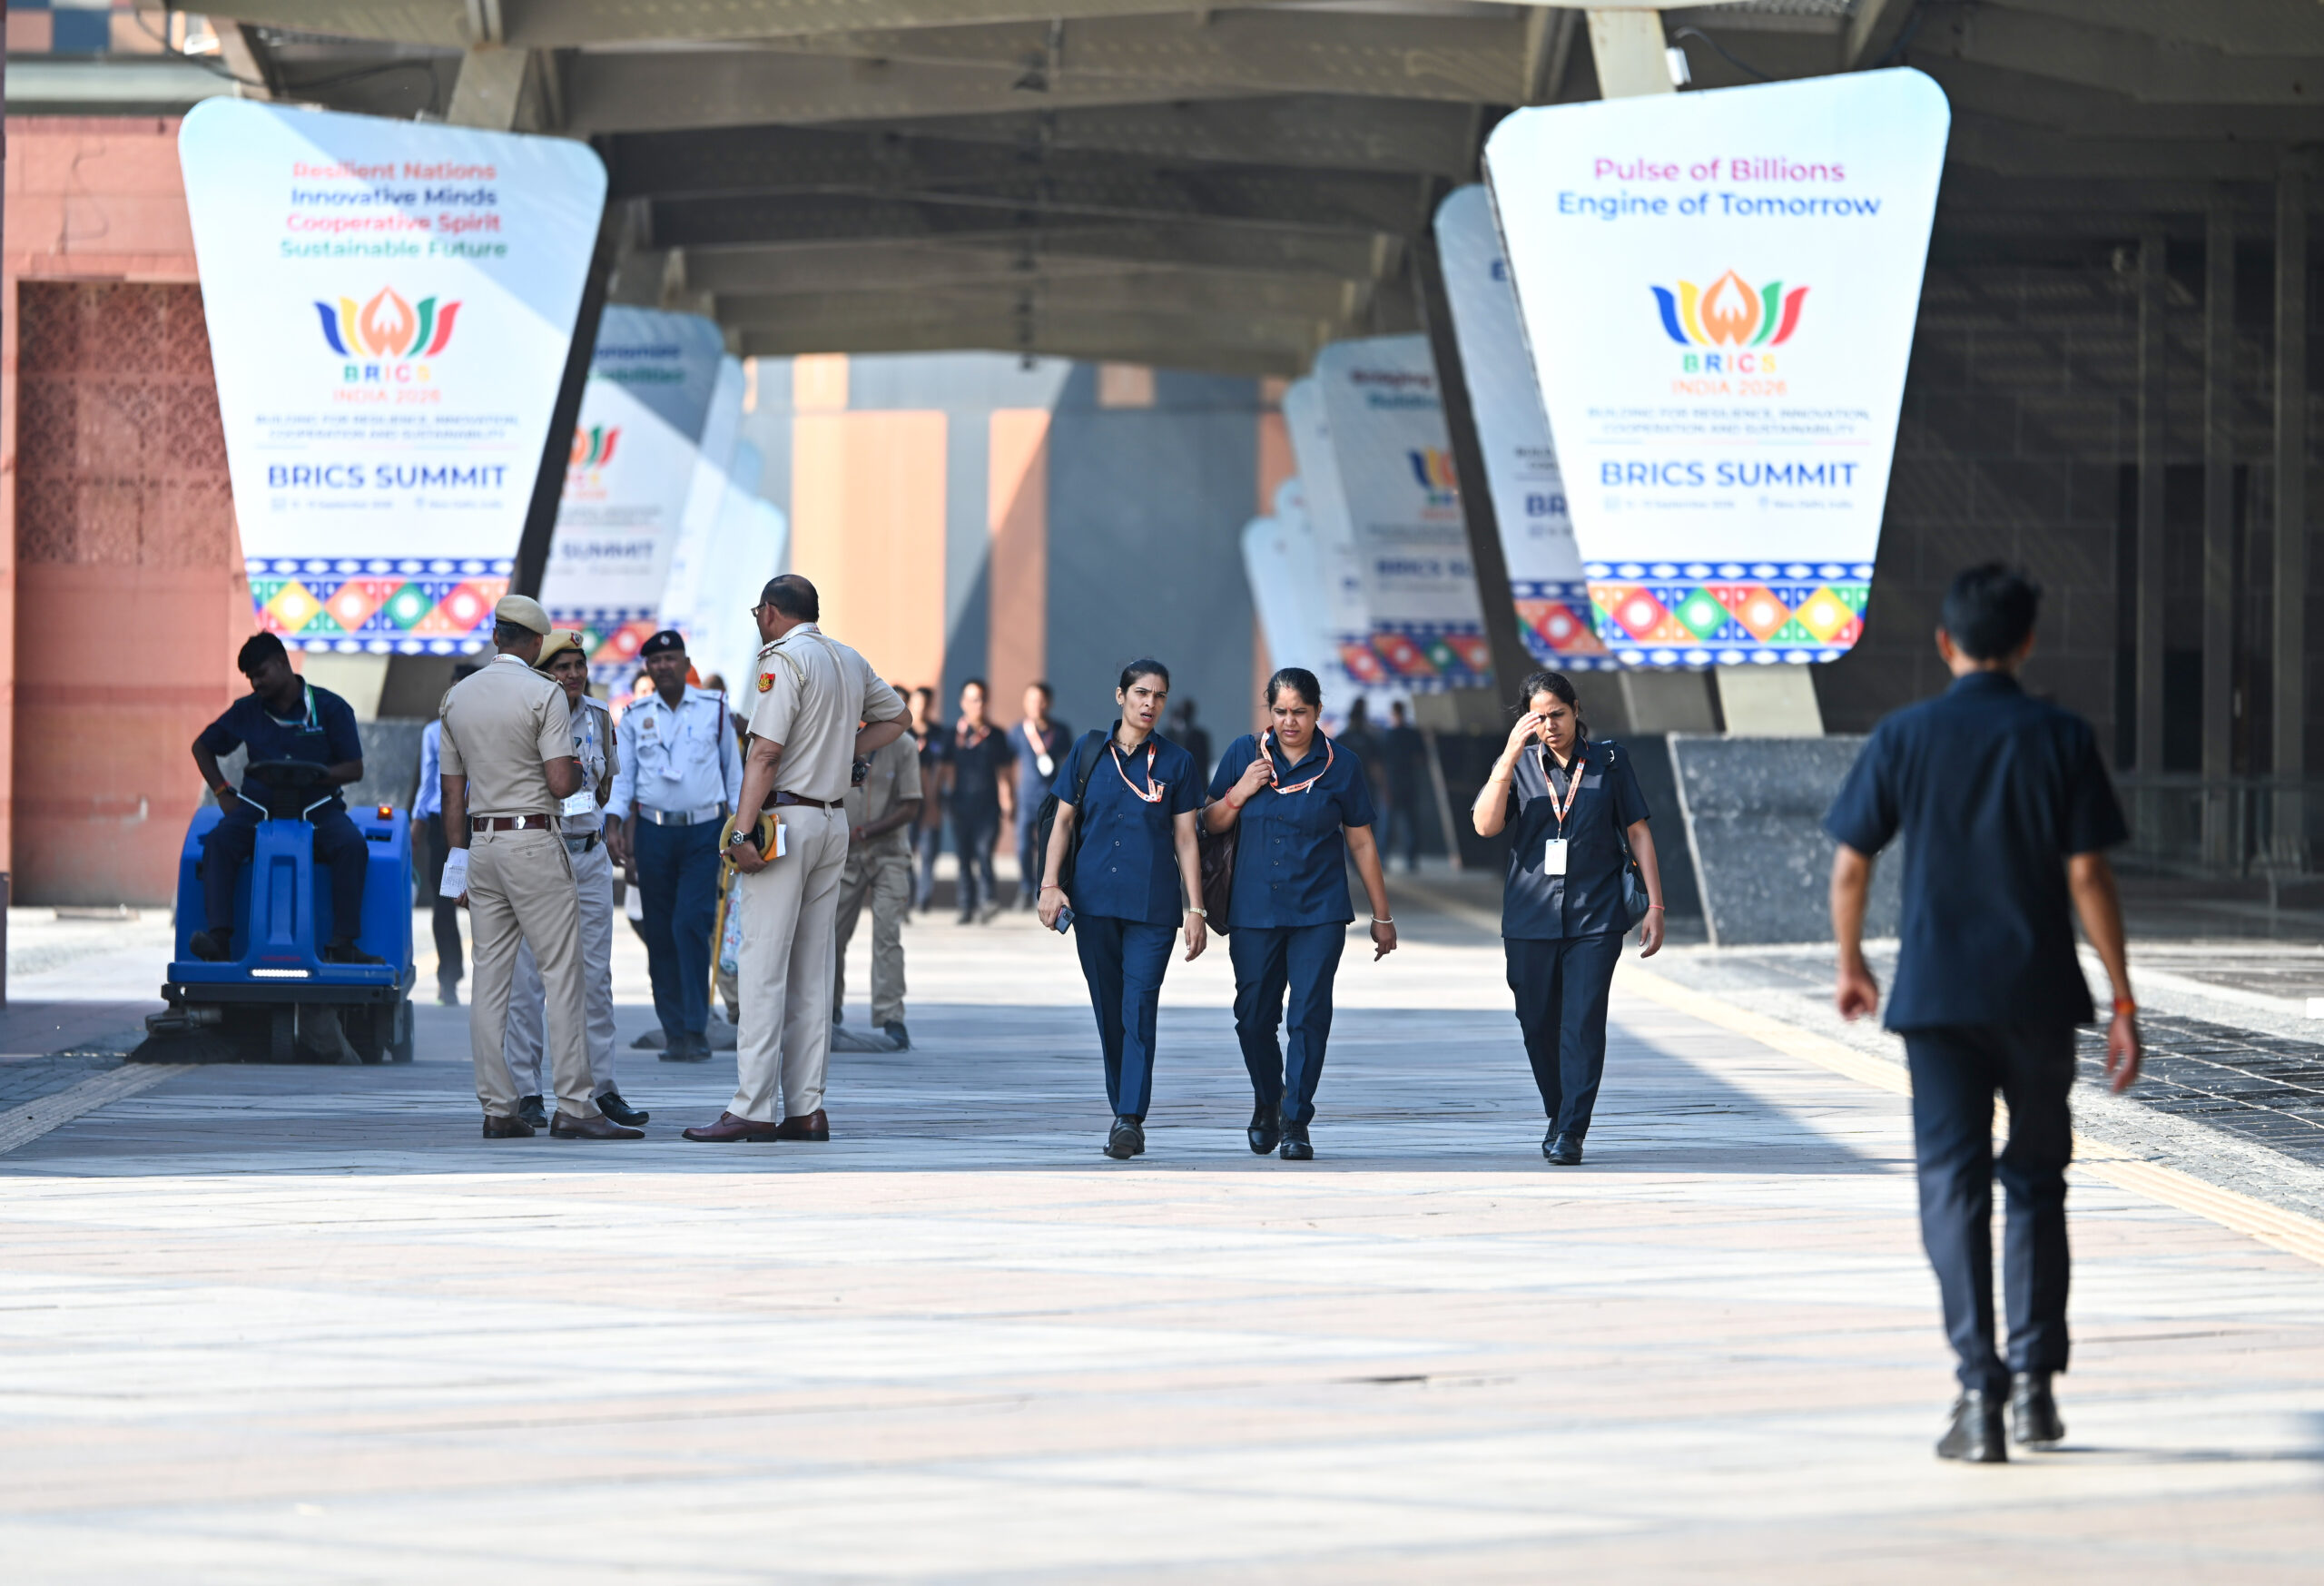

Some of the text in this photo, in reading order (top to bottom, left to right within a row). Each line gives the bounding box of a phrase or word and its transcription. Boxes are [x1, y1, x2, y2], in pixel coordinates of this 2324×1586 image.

[293, 161, 497, 180] Resilient Nations
[1595, 157, 1845, 182] Pulse of Billions
[291, 187, 497, 206] Innovative Minds
[1558, 191, 1881, 221] Engine of Tomorrow
[287, 212, 501, 235] Cooperative Spirit
[280, 239, 508, 259] Sustainable Future
[344, 364, 431, 382] BRICS
[1683, 352, 1777, 374] BRICS
[333, 389, 442, 404] INDIA 2026
[1671, 379, 1787, 396] INDIA 2026
[268, 464, 507, 488] BRICS SUMMIT
[1600, 461, 1858, 488] BRICS SUMMIT
